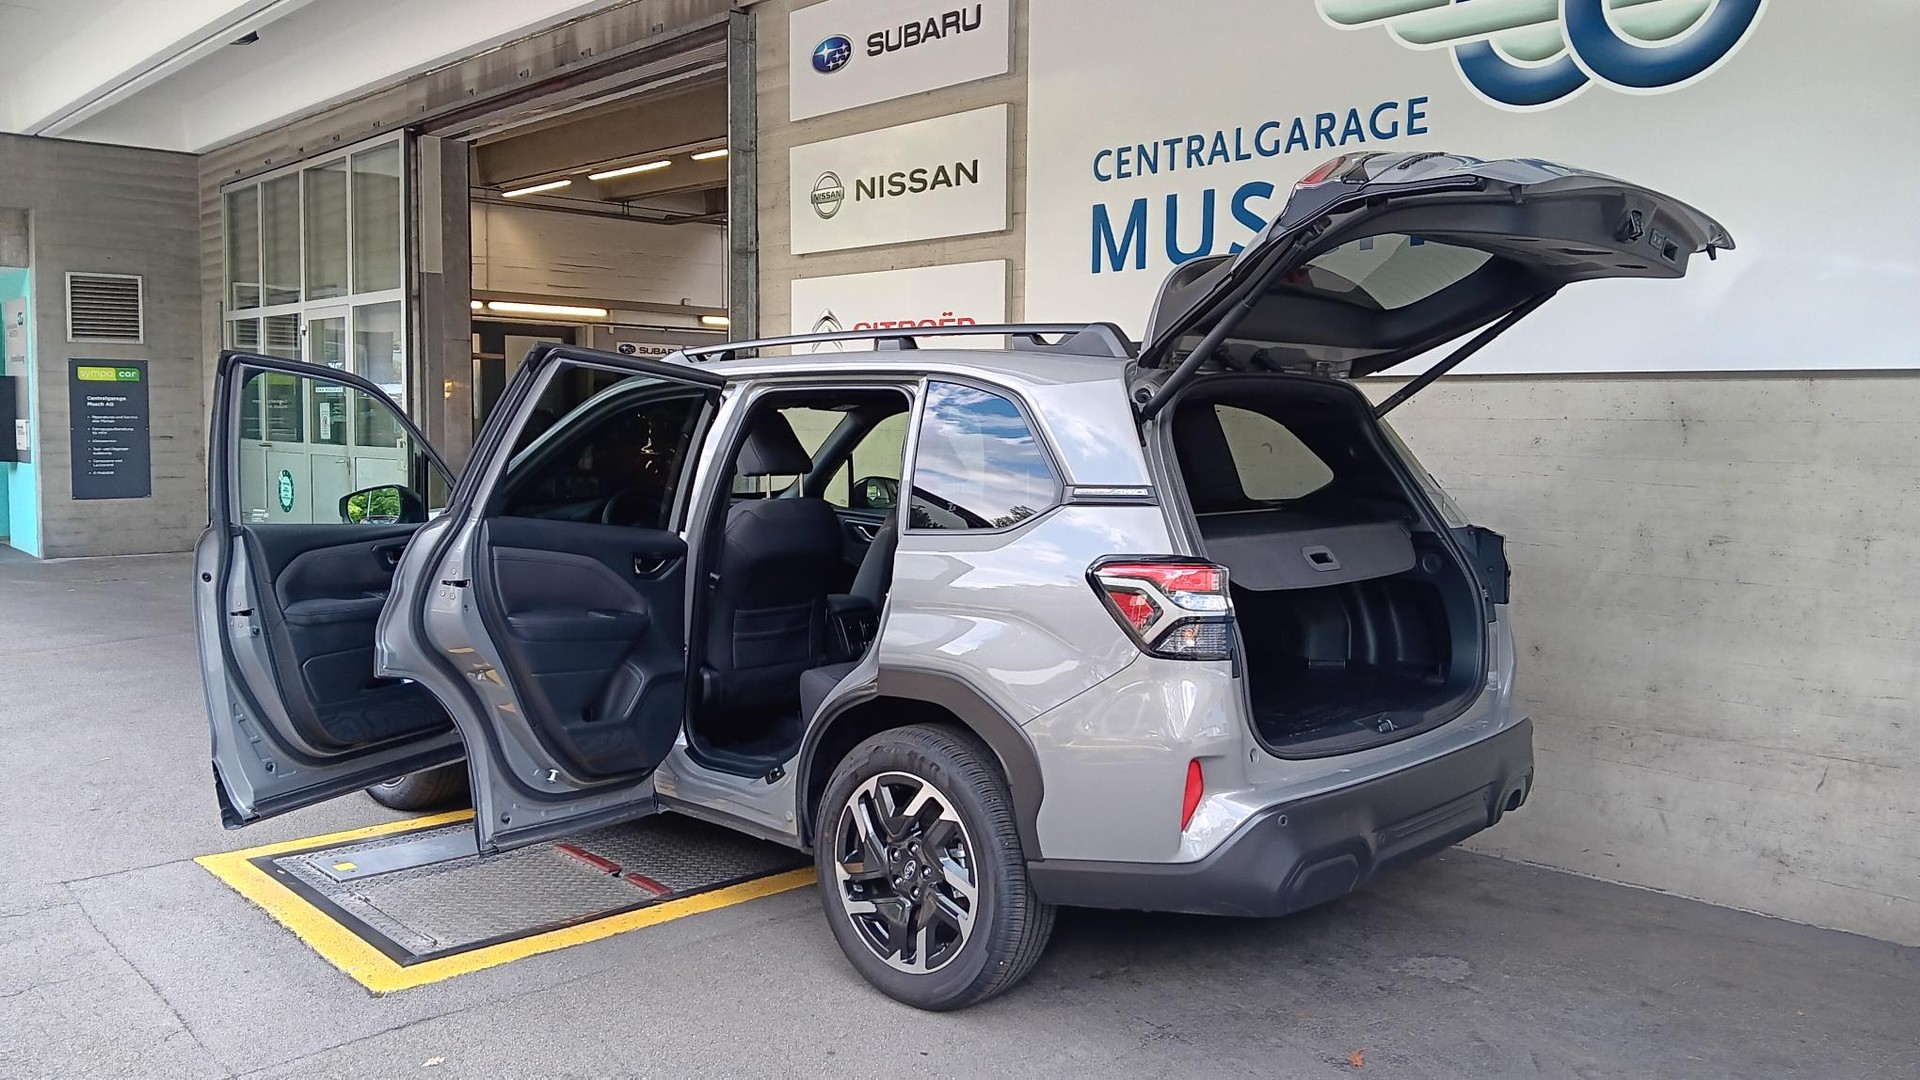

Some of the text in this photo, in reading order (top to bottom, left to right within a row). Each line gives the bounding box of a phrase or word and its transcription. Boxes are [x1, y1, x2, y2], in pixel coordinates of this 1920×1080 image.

[867, 4, 982, 57] SUBARU
[1093, 96, 1429, 182] CENTRALGARAGE
[813, 189, 843, 201] NISSAN
[855, 159, 979, 202] NISSAN
[639, 346, 680, 355] SUBAR
